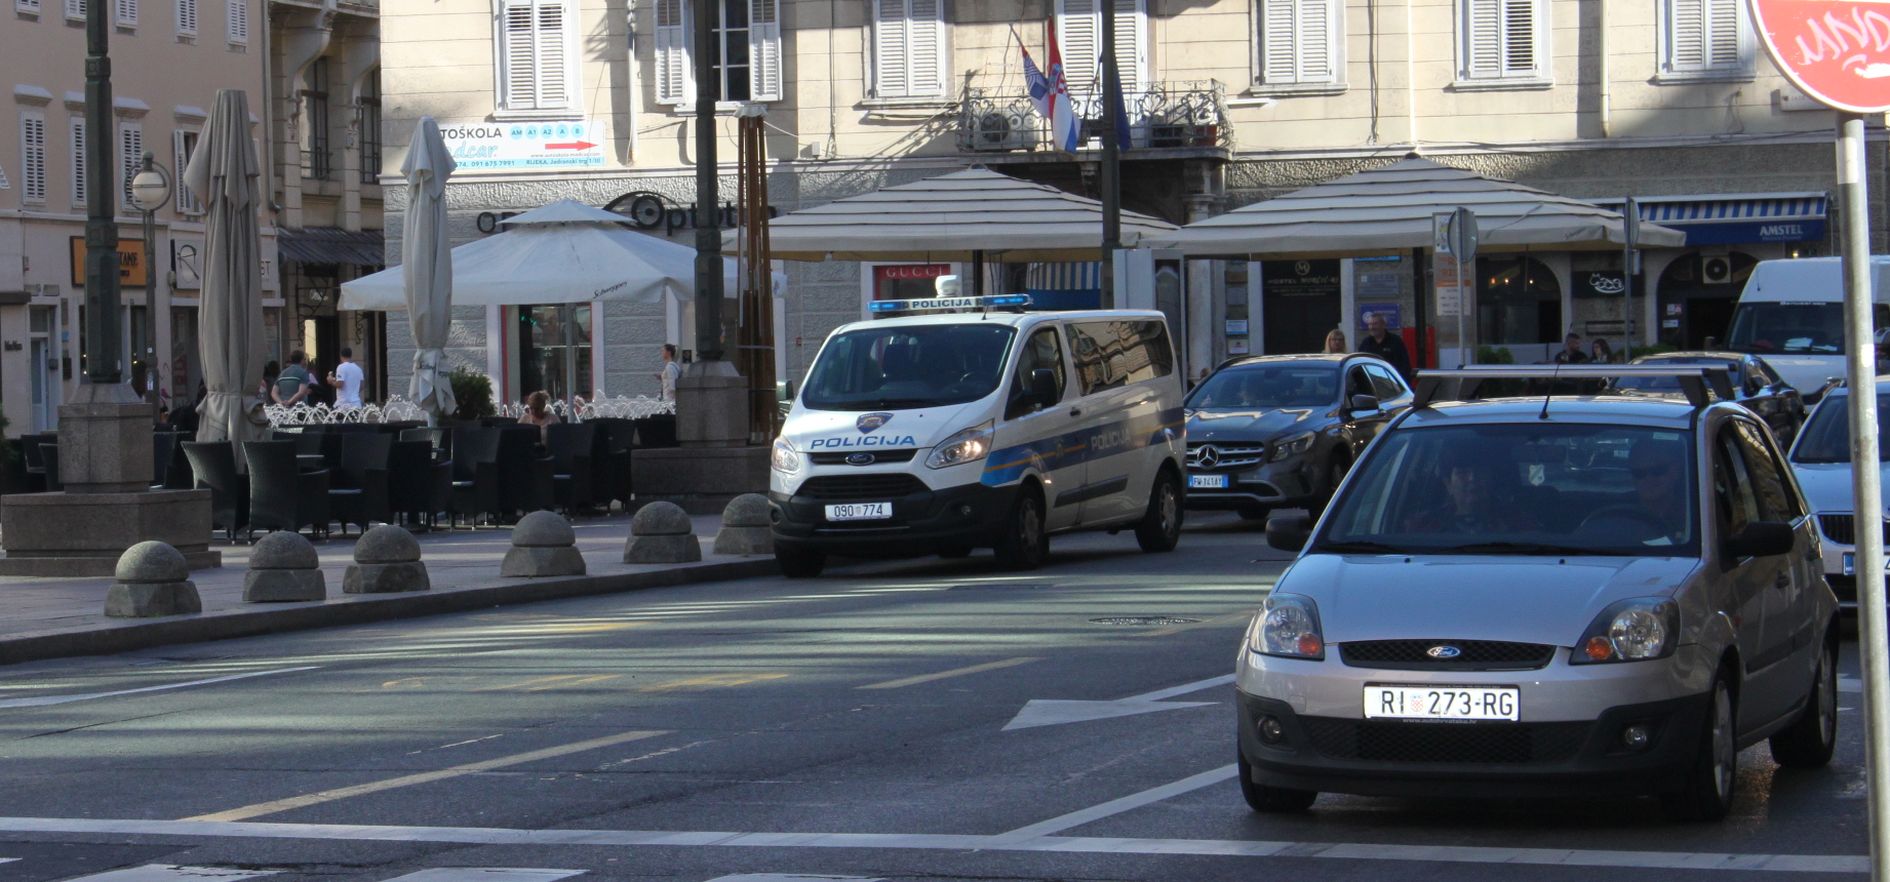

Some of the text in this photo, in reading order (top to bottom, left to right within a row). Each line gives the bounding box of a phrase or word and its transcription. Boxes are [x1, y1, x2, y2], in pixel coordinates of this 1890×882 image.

[440, 125, 502, 139] TOŠKOLA
[1760, 224, 1803, 236] AMSTEL
[886, 266, 942, 278] GUCCI
[912, 299, 973, 309] POLICIJA
[810, 436, 916, 450] POLICIJA
[834, 504, 883, 517] 090 774
[1382, 690, 1513, 716] RI 273-RG
